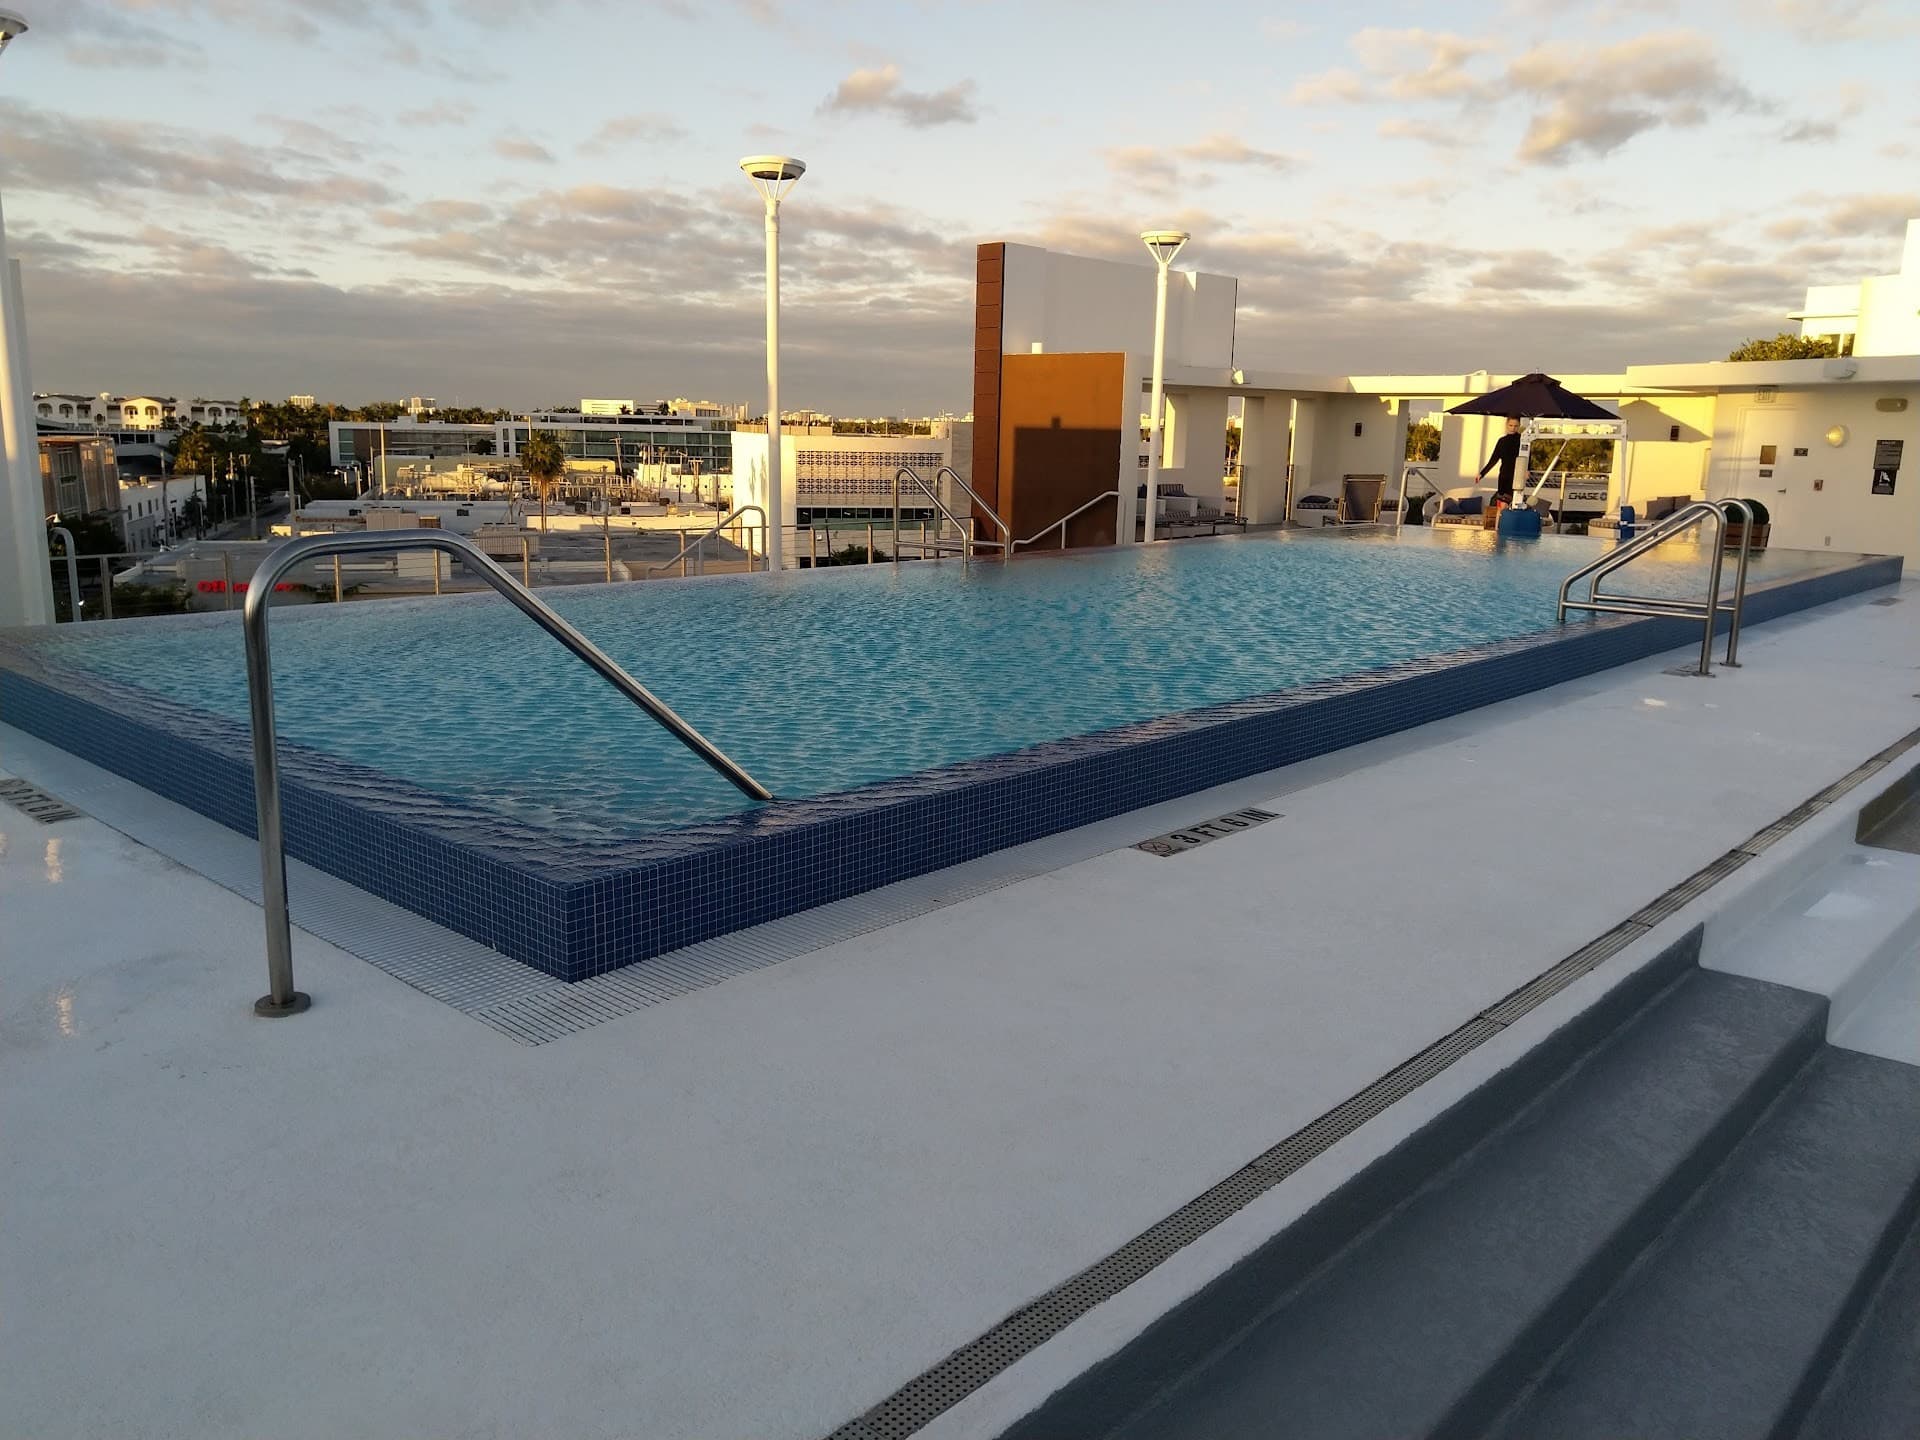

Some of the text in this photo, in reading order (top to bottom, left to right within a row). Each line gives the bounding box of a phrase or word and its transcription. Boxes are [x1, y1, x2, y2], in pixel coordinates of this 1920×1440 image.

[1568, 492, 1599, 500] CHASE
[197, 580, 250, 592] Offce
[1170, 834, 1201, 844] 3
[1220, 818, 1250, 827] 6
